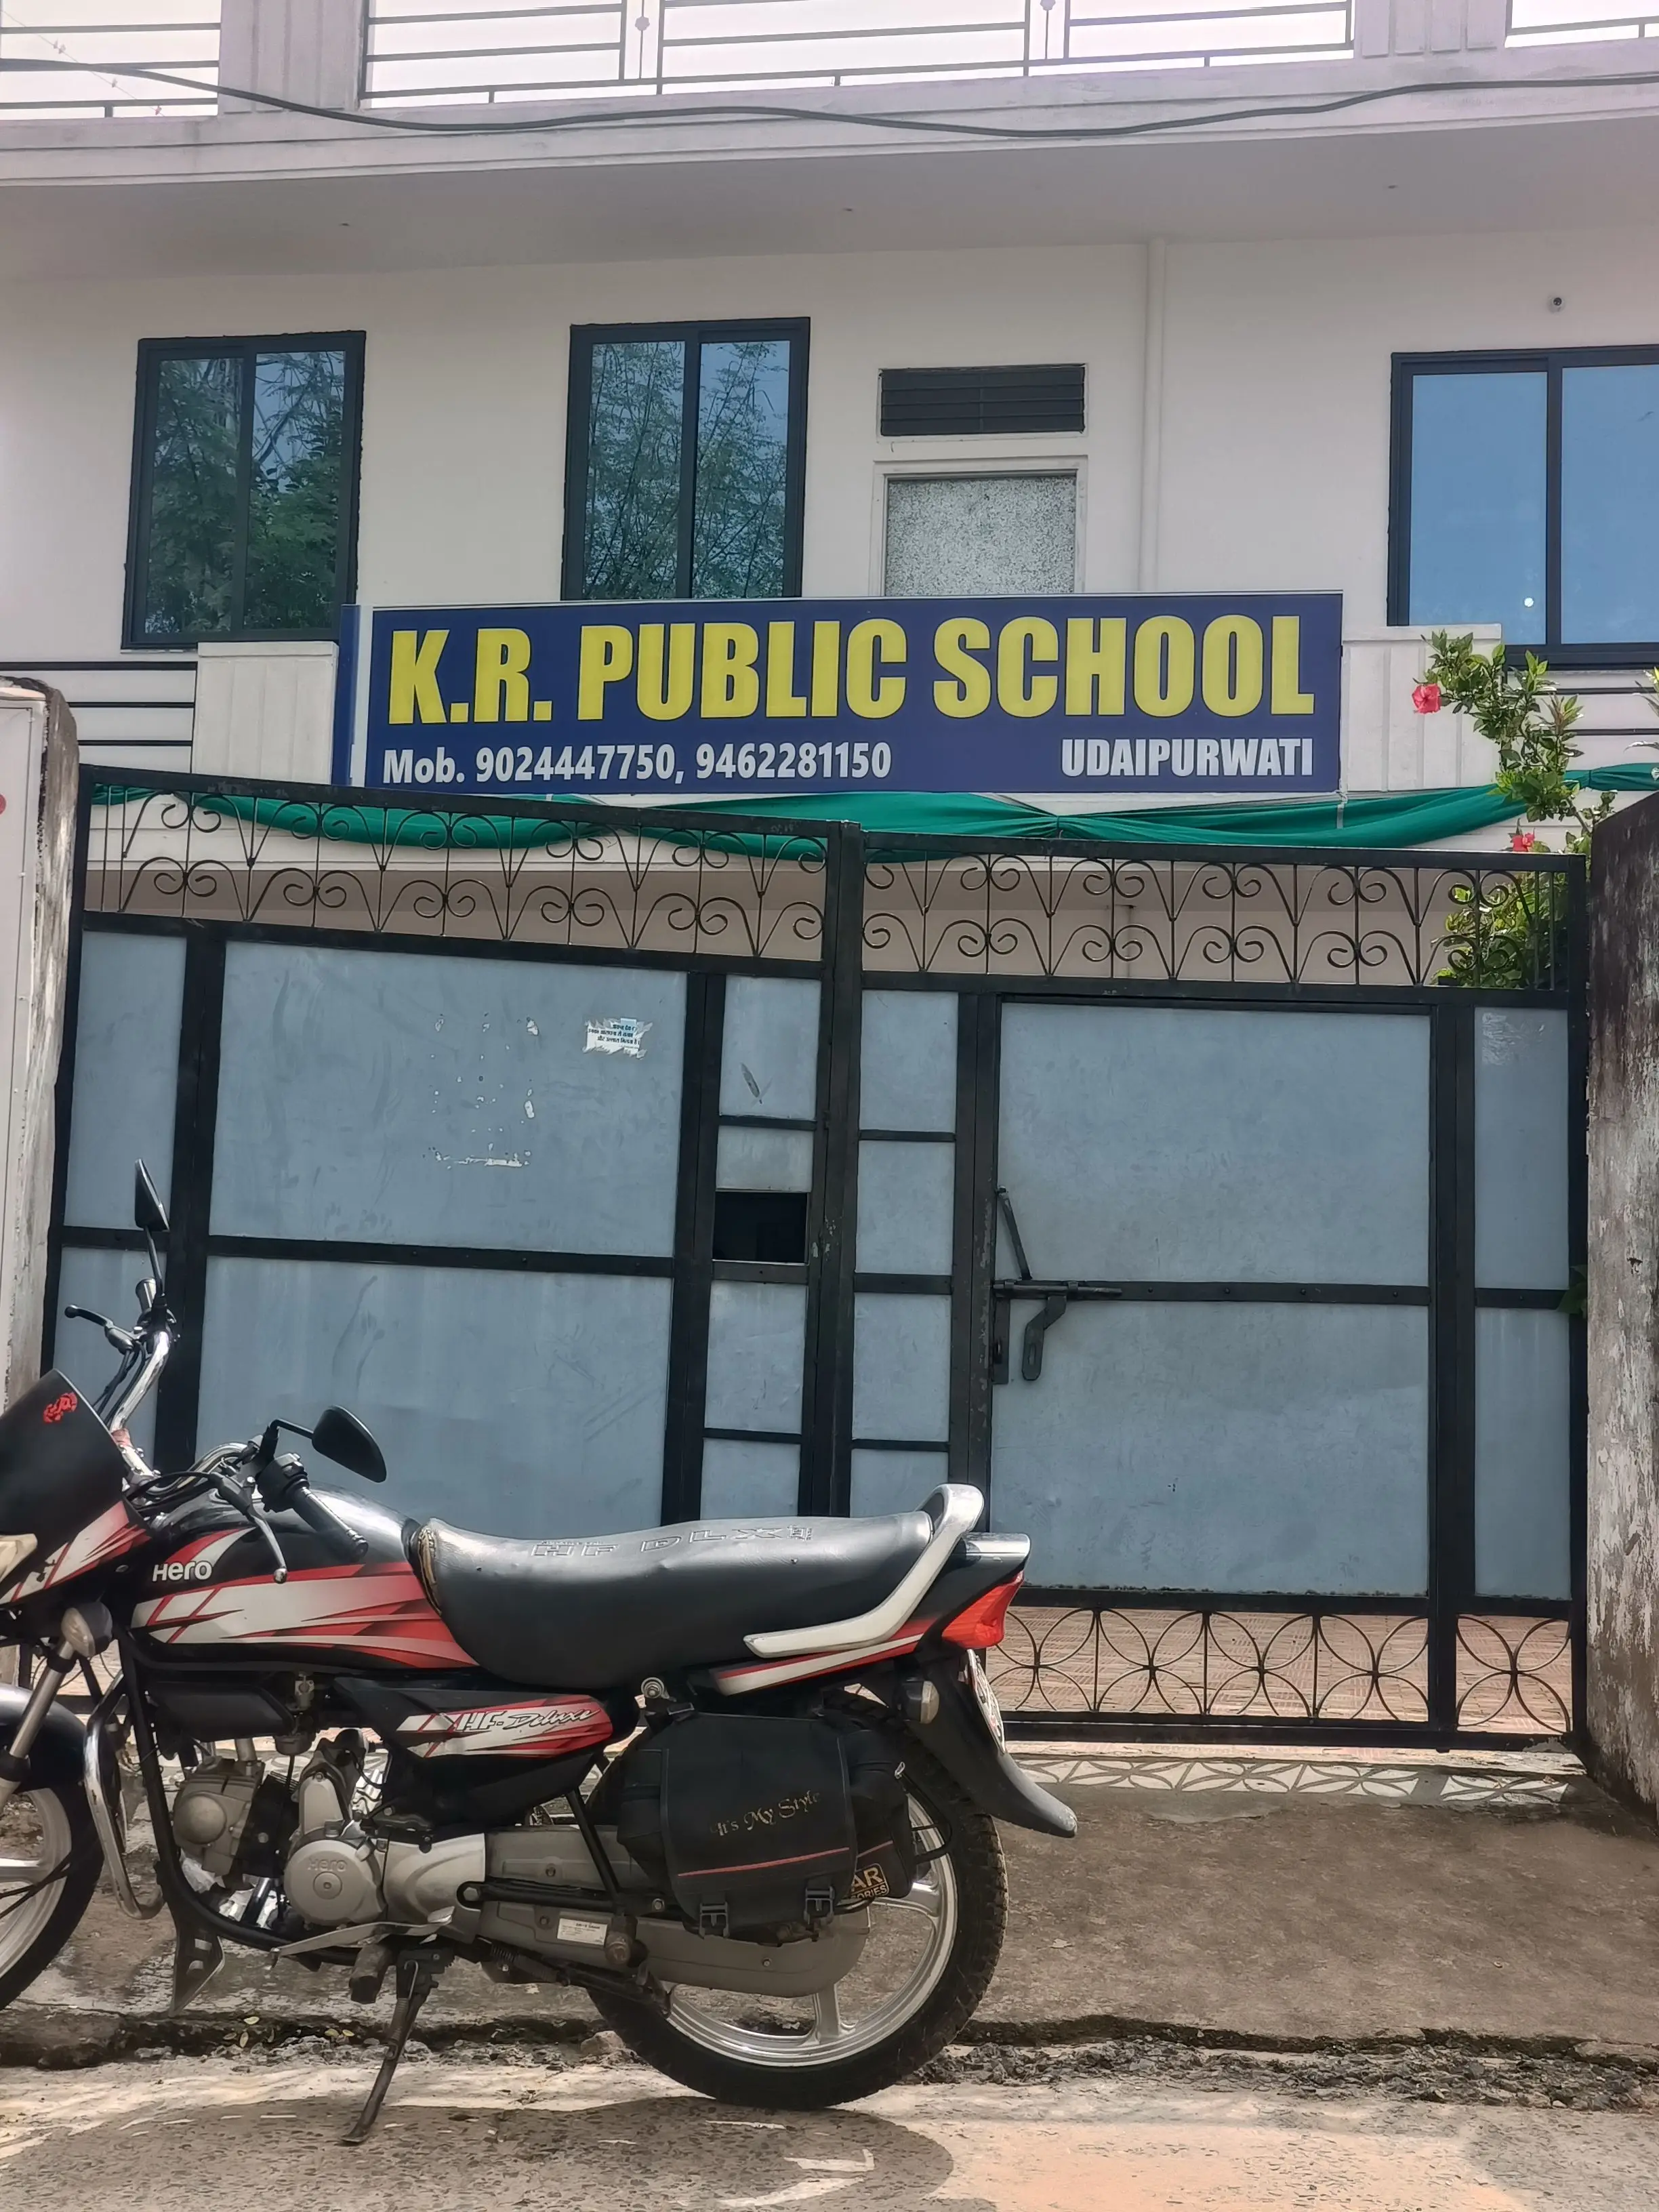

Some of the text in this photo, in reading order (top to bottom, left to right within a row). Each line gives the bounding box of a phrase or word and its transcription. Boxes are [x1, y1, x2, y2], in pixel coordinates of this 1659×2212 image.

[388, 614, 1315, 724] K.R. PUBLIC SCHOOL
[383, 741, 892, 784] Mob. 9024447750, 9462281150
[1061, 738, 1313, 777] UDAIPURWATI
[743, 1807, 777, 1830] My
[779, 1790, 821, 1819] Style
[851, 1885, 887, 1898] ORIES
